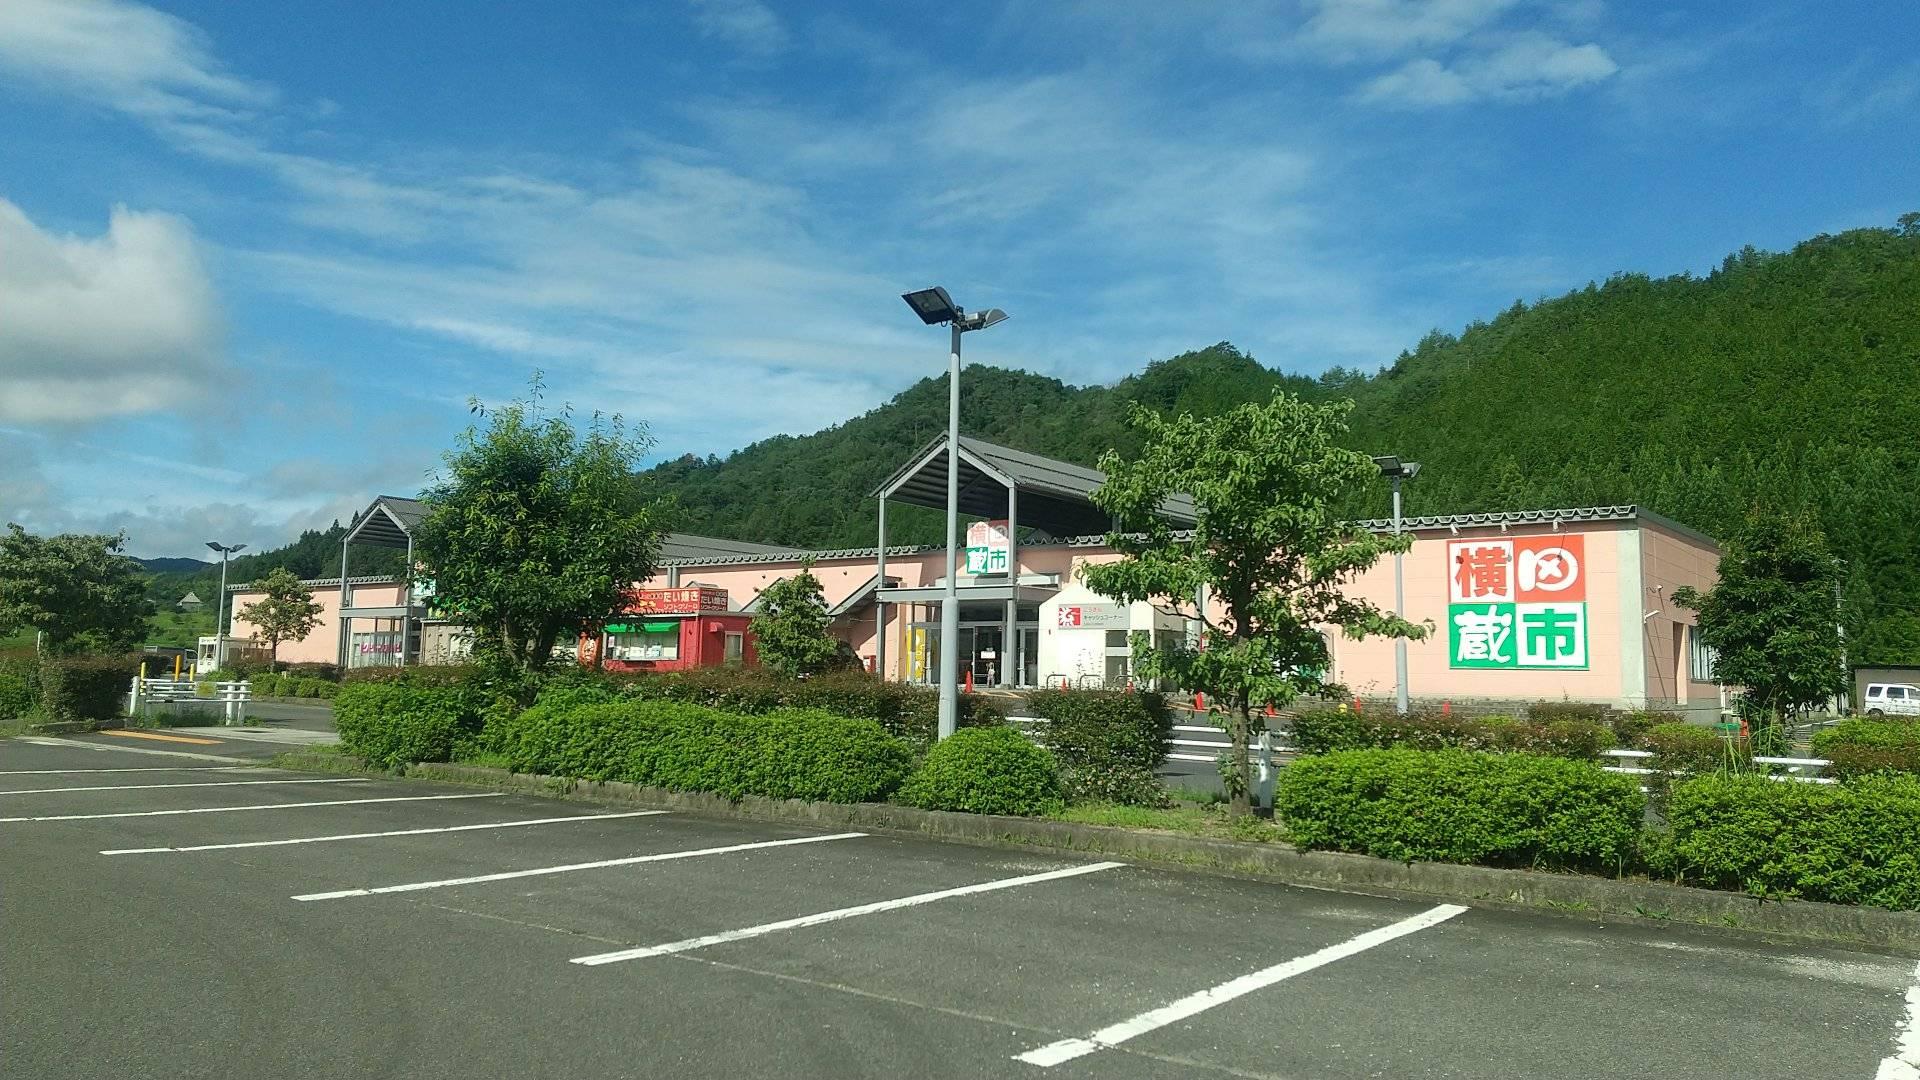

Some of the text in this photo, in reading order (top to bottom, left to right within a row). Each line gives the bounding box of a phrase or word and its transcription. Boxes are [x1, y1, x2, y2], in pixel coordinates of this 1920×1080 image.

[663, 591, 699, 603] たい焼き
[1453, 604, 1578, 664] 蔵市
